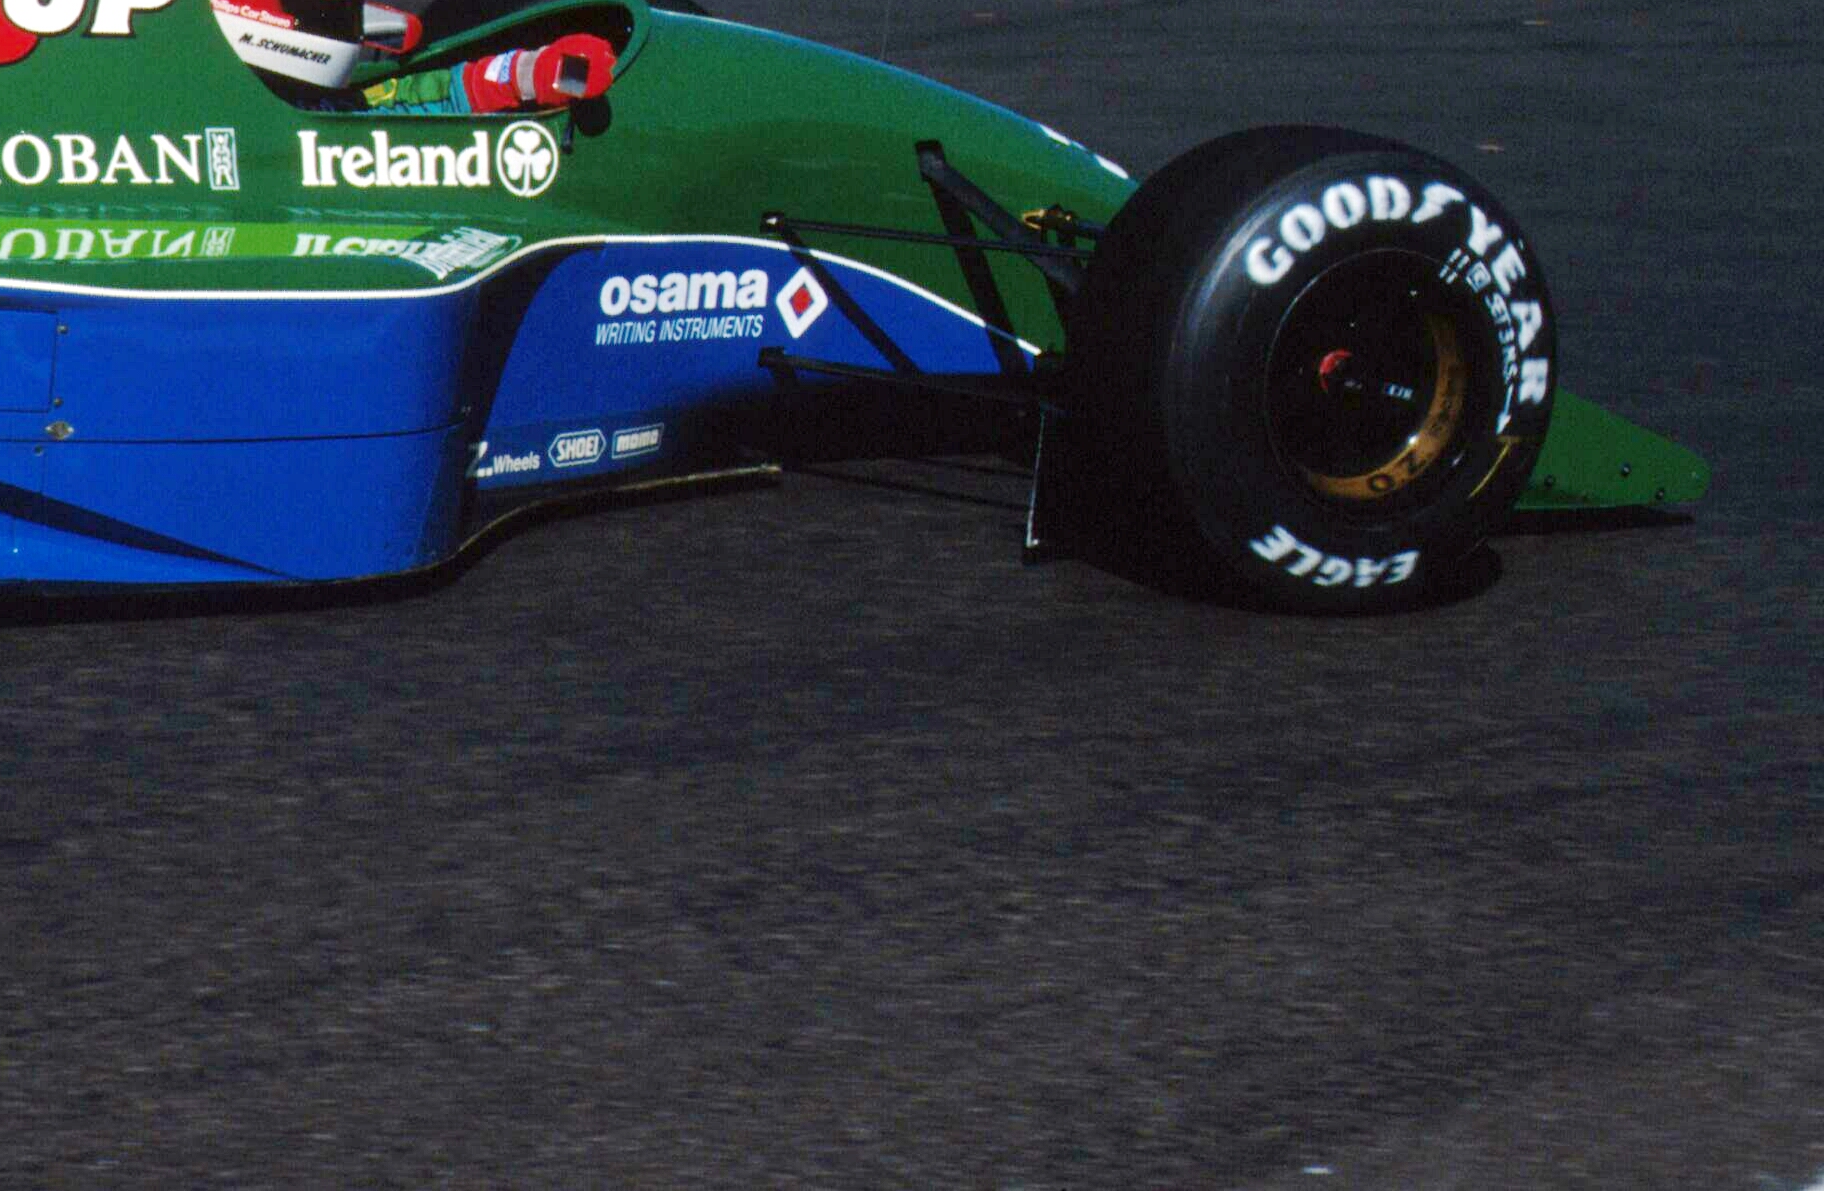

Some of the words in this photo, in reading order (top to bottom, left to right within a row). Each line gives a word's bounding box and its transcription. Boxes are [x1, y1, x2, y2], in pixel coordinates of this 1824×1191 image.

[297, 130, 491, 187] Ireland
[600, 269, 769, 316] osama
[1245, 176, 1550, 404] GOODYEAR
[595, 319, 656, 345] WRITING
[659, 315, 764, 342] INSTRUMENTS
[493, 451, 540, 474] Wheels
[556, 435, 600, 462] SHOEI
[1248, 524, 1420, 588] EAGLE
